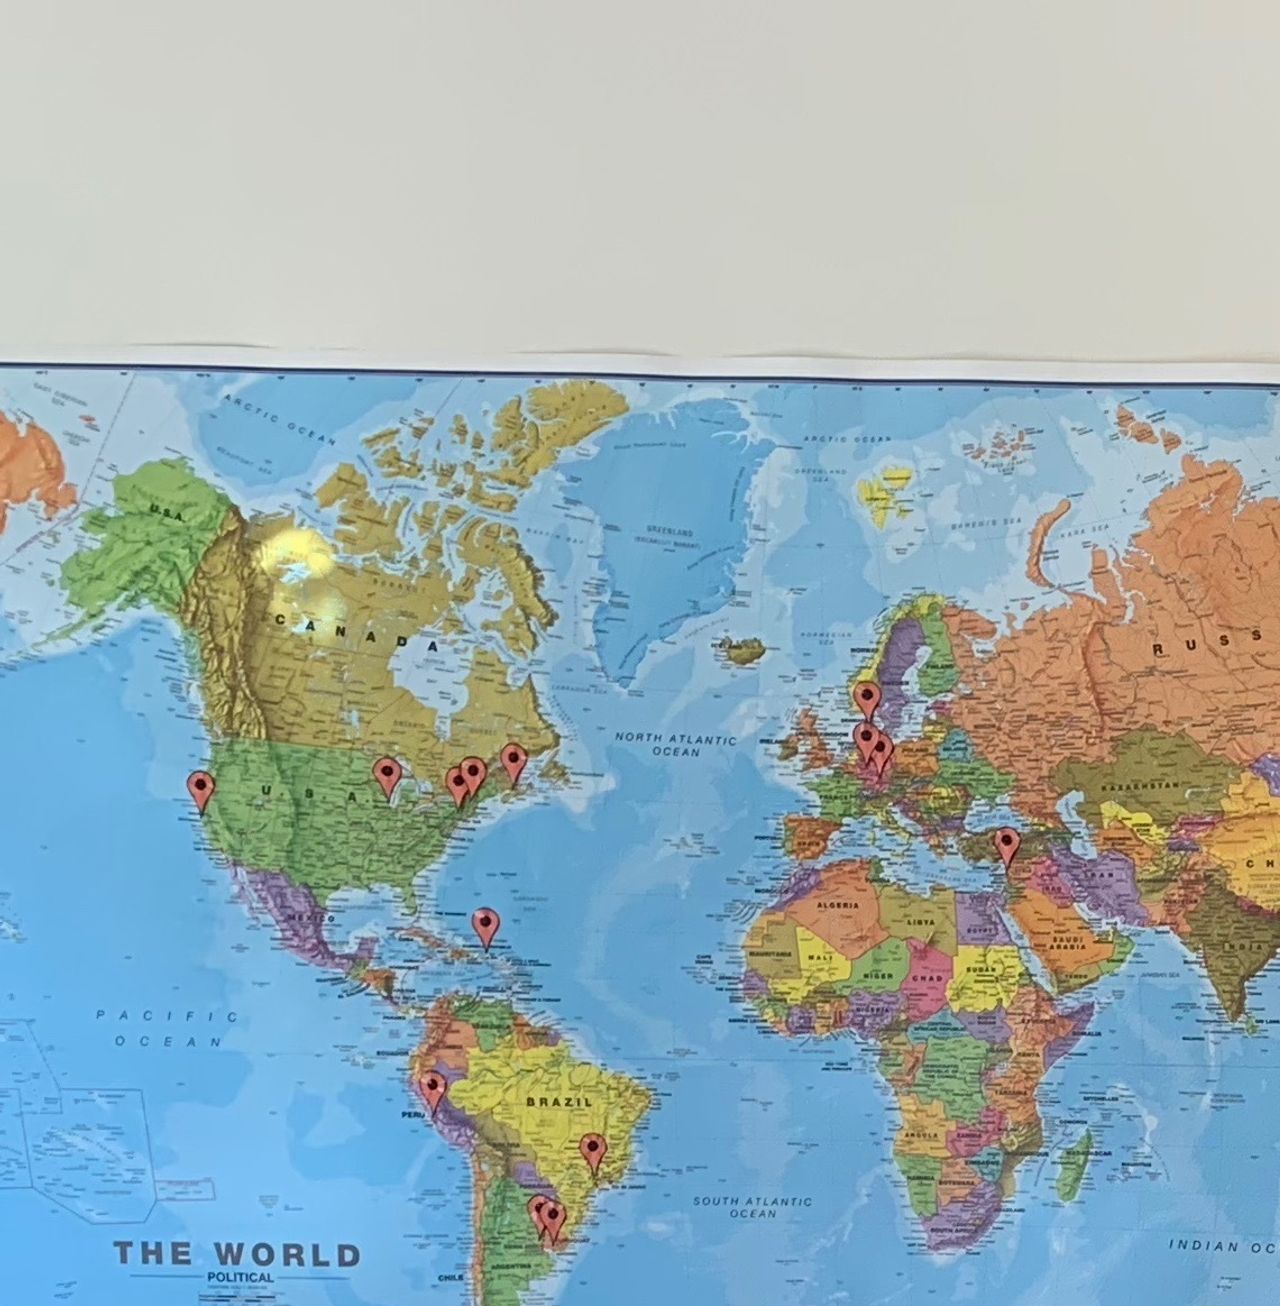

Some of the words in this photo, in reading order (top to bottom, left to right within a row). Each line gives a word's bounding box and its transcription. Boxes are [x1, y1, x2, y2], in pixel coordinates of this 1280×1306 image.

[223, 394, 279, 423] ARCTIC
[287, 421, 337, 447] OCEAN
[854, 435, 892, 443] OCEAN
[150, 503, 187, 524] U.S.A.
[275, 612, 438, 654] CANADA
[615, 732, 662, 743] NORTH
[668, 734, 737, 746] ATLANTIC
[652, 747, 700, 758] OCEAN
[1101, 781, 1180, 792] KAZAKHSTAN
[817, 902, 859, 910] ALGERIA
[906, 919, 935, 927] LIBYA
[1053, 936, 1083, 944] SAUDI
[966, 966, 997, 974] SUDAN
[912, 975, 943, 983] CHAD
[96, 1009, 237, 1022] PACIFIC
[115, 1035, 221, 1048] OCEAN
[526, 1097, 593, 1107] BRAZIL
[401, 1111, 425, 1119] PERU
[693, 1196, 739, 1207] SOUTH
[745, 1197, 813, 1207] ATLANTIC
[730, 1208, 777, 1219] OCEAN
[1169, 1239, 1238, 1252] INDIAN
[113, 1241, 193, 1265] THE
[212, 1242, 361, 1268] WORLD
[207, 1271, 275, 1284] POLITICAL
